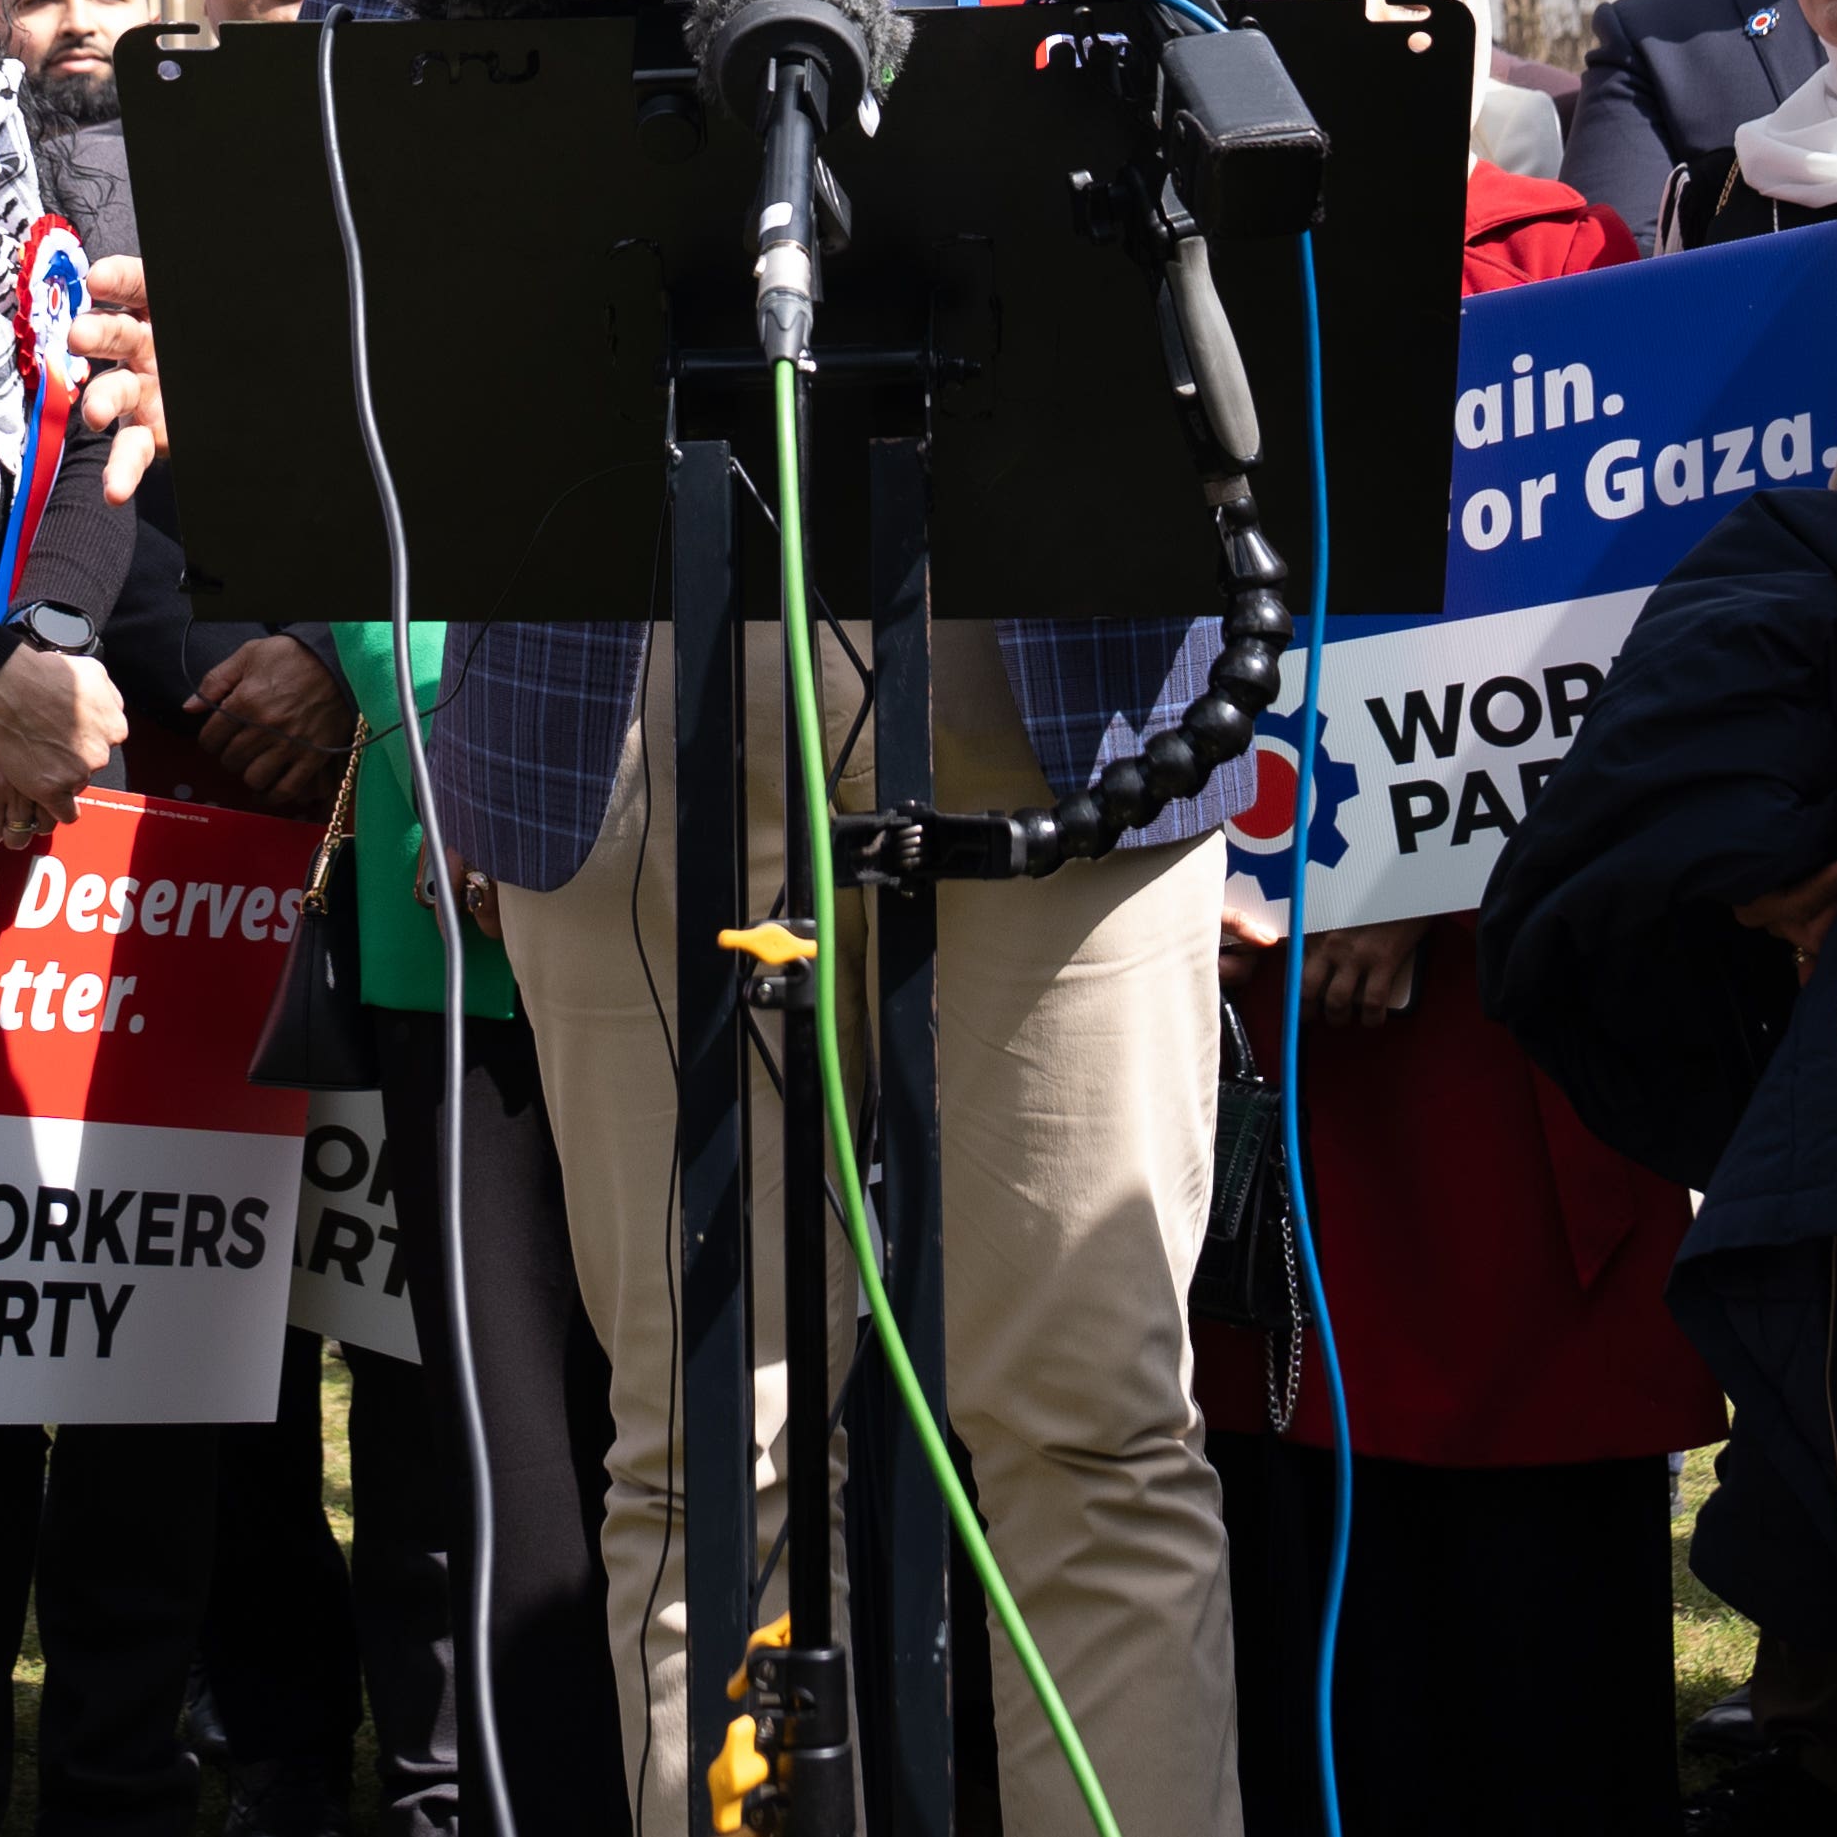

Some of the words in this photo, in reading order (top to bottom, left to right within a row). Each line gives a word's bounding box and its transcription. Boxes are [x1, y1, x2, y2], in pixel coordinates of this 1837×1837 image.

[1455, 353, 1624, 450] ain.
[1448, 472, 1557, 552] or
[14, 854, 304, 943] Deserves
